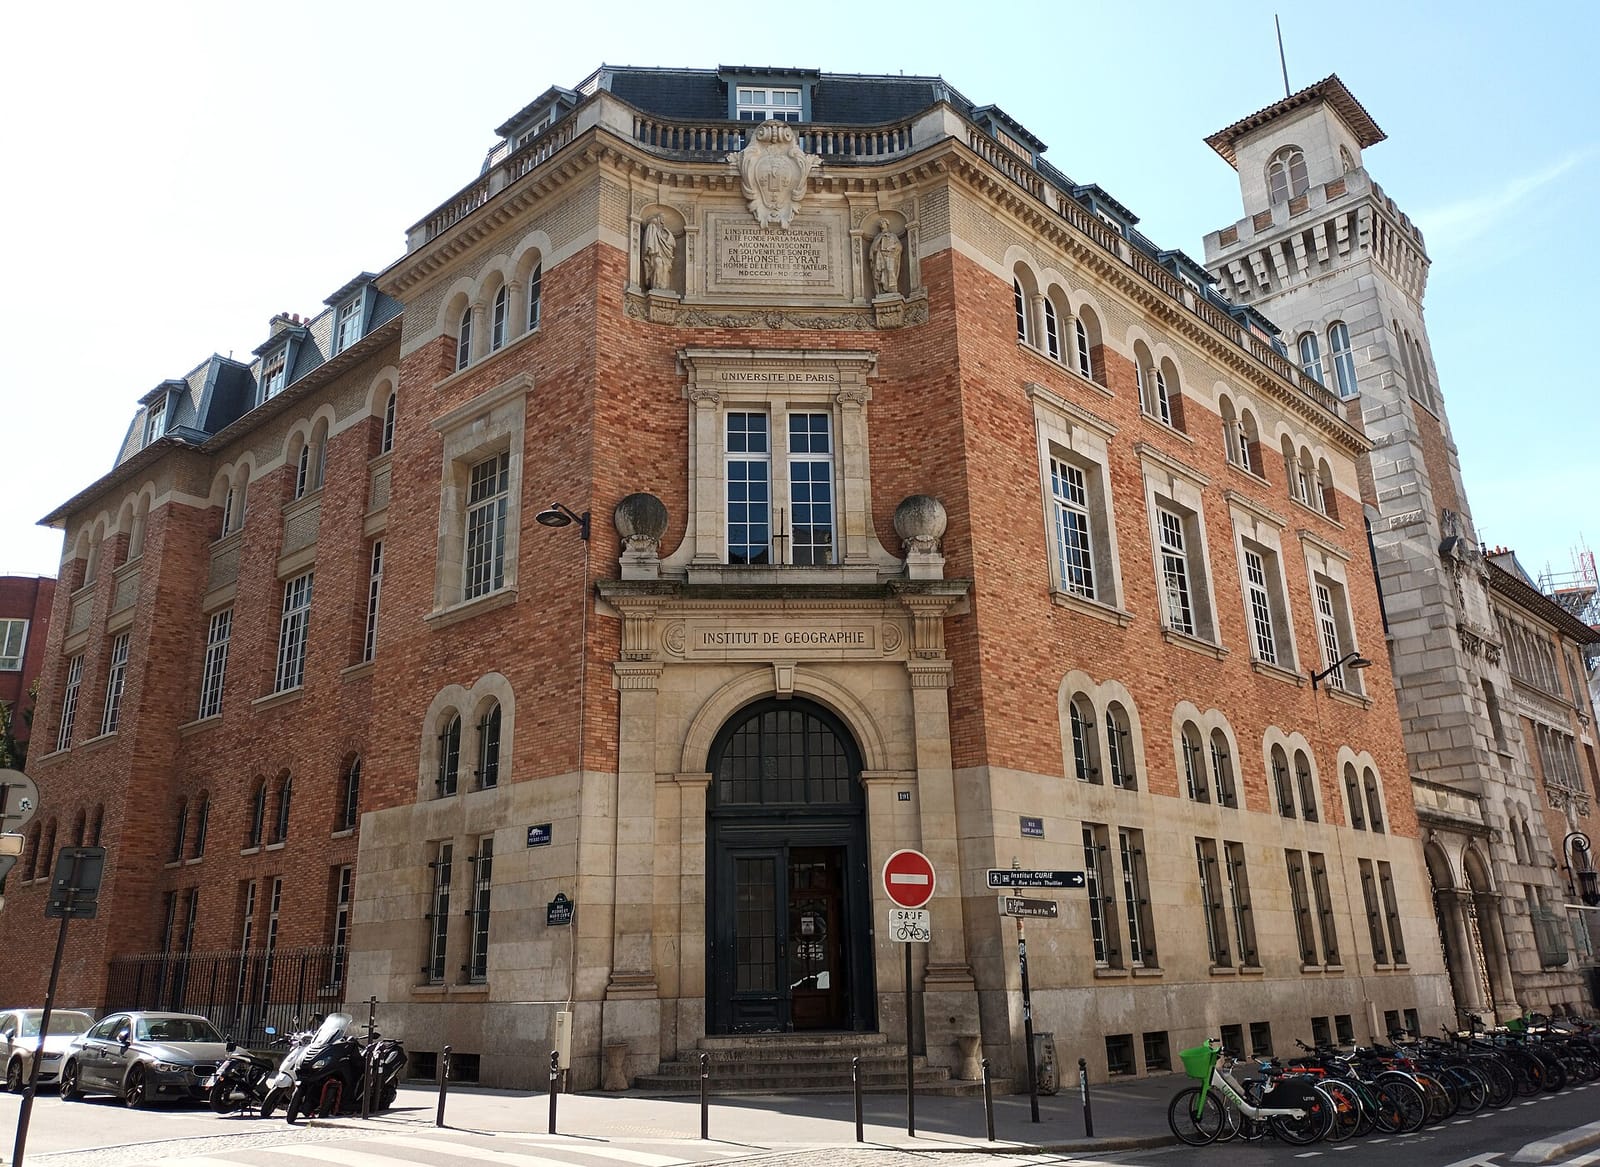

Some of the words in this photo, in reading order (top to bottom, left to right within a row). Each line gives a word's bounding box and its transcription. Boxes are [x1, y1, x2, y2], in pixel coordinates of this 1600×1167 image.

[777, 229, 824, 237] GEOGRAPHIE
[728, 255, 779, 264] ALPHONSE
[782, 255, 820, 264] PEYRAT
[721, 371, 785, 381] UNIVERSITE
[788, 372, 802, 381] DE
[805, 373, 835, 382] PARIS
[703, 631, 758, 644] INSTITUT
[763, 631, 780, 644] DE
[784, 631, 865, 644] GEOGRAPHIE
[1010, 871, 1033, 879] Institut
[897, 911, 923, 920] SAUF
